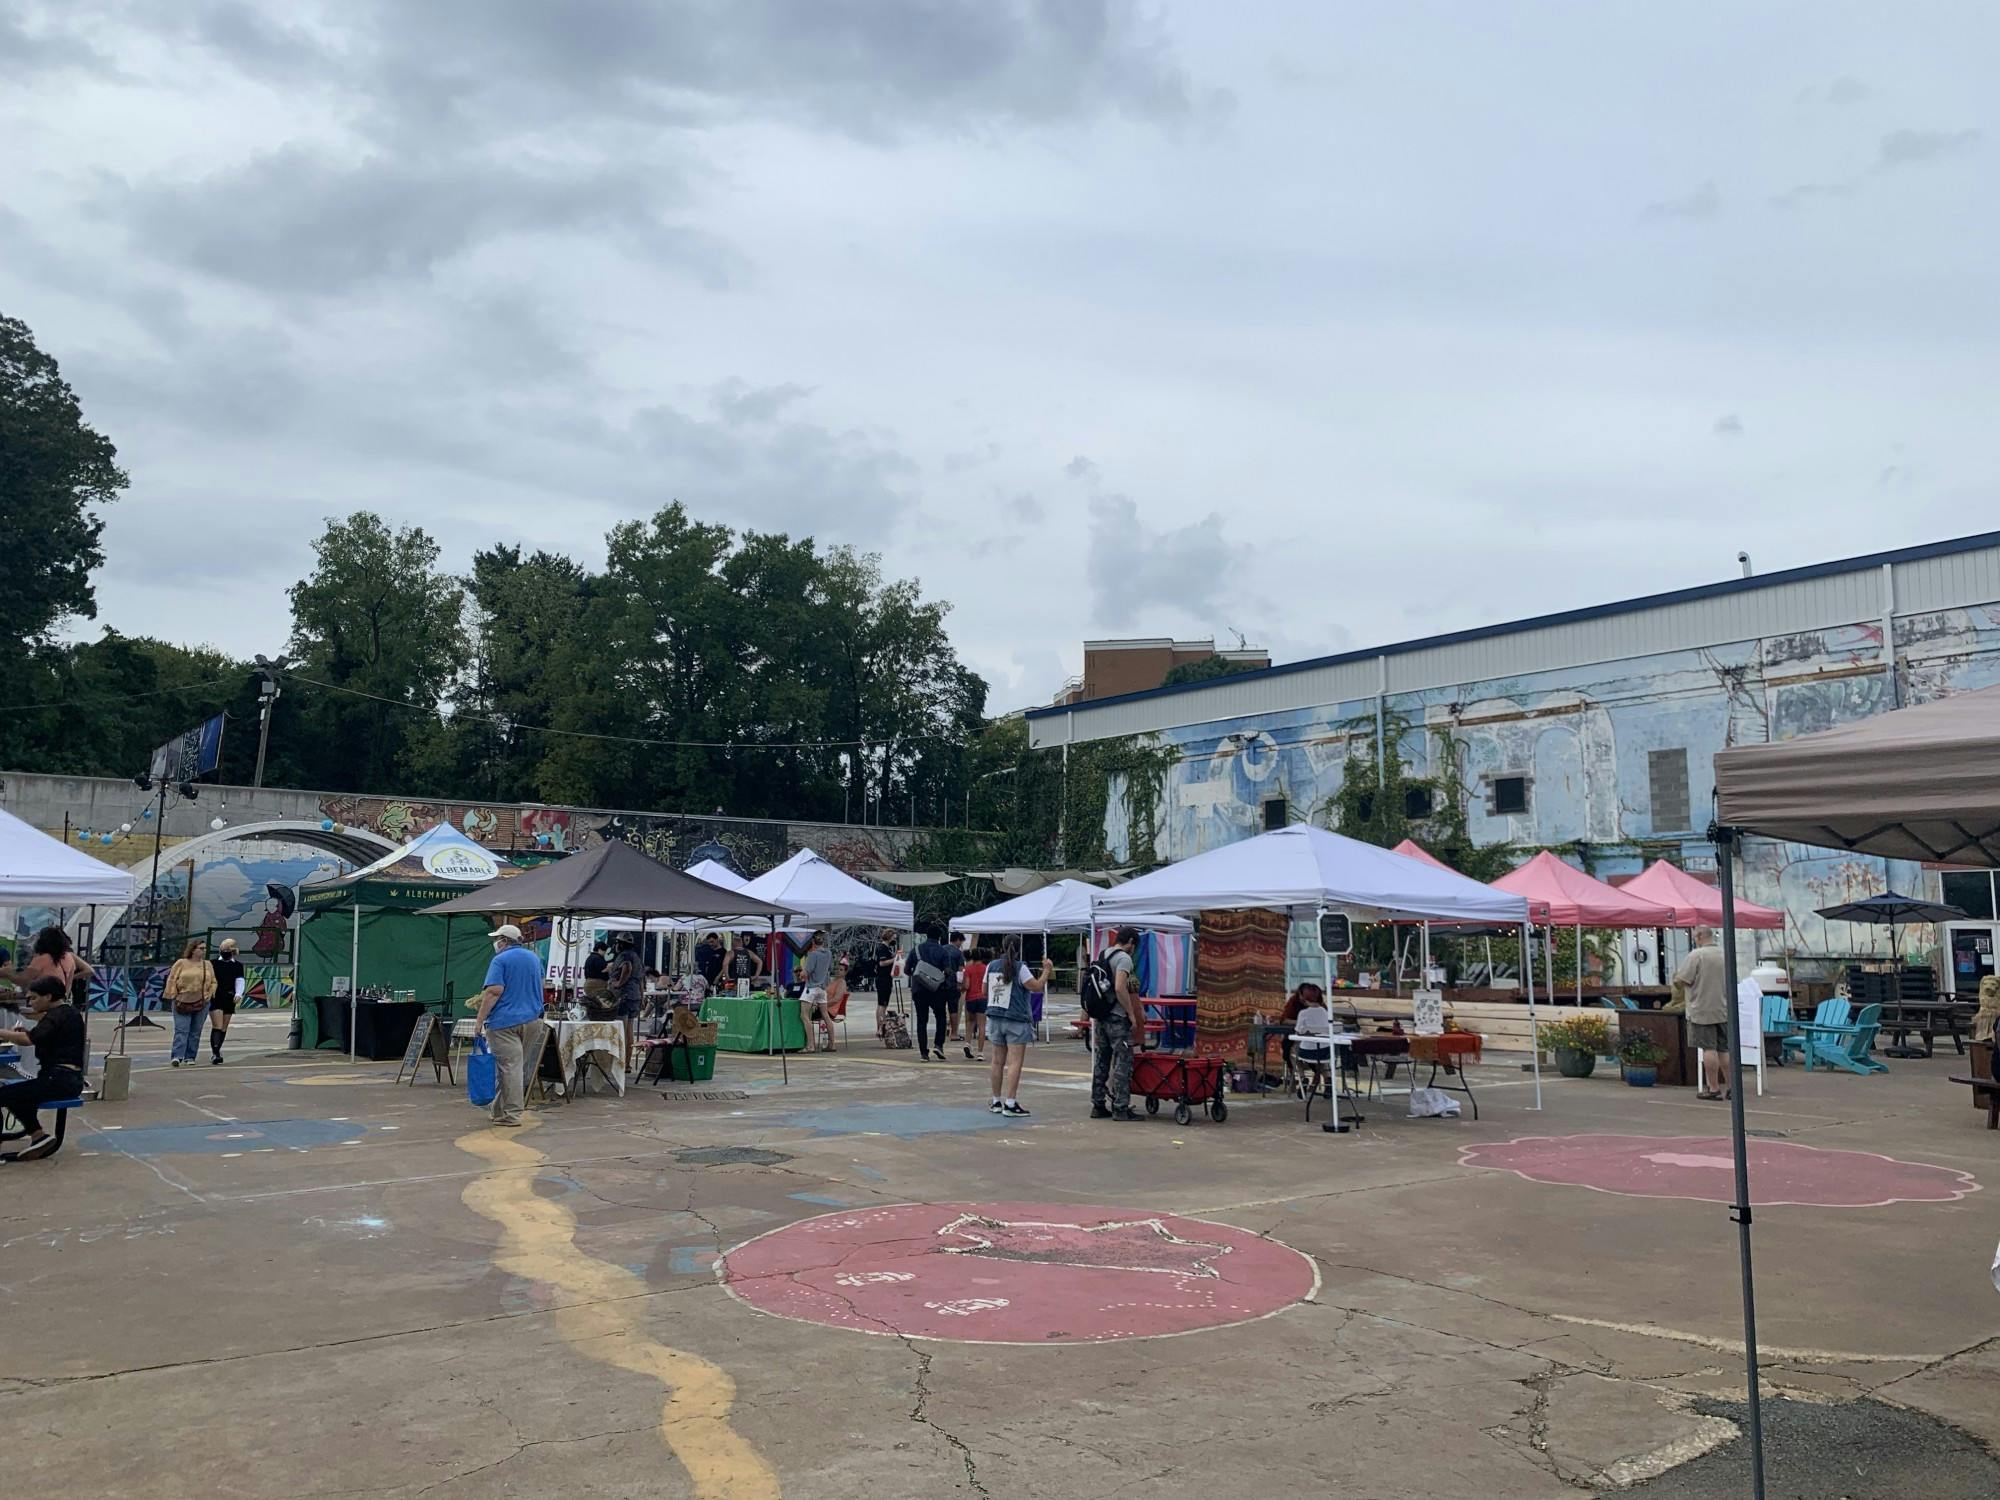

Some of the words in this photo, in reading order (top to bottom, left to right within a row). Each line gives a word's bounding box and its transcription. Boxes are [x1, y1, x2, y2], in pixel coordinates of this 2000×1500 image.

[434, 865, 494, 875] ALBEMARLE
[405, 890, 469, 899] ALBEMARLEH
[550, 966, 585, 978] EVEN
